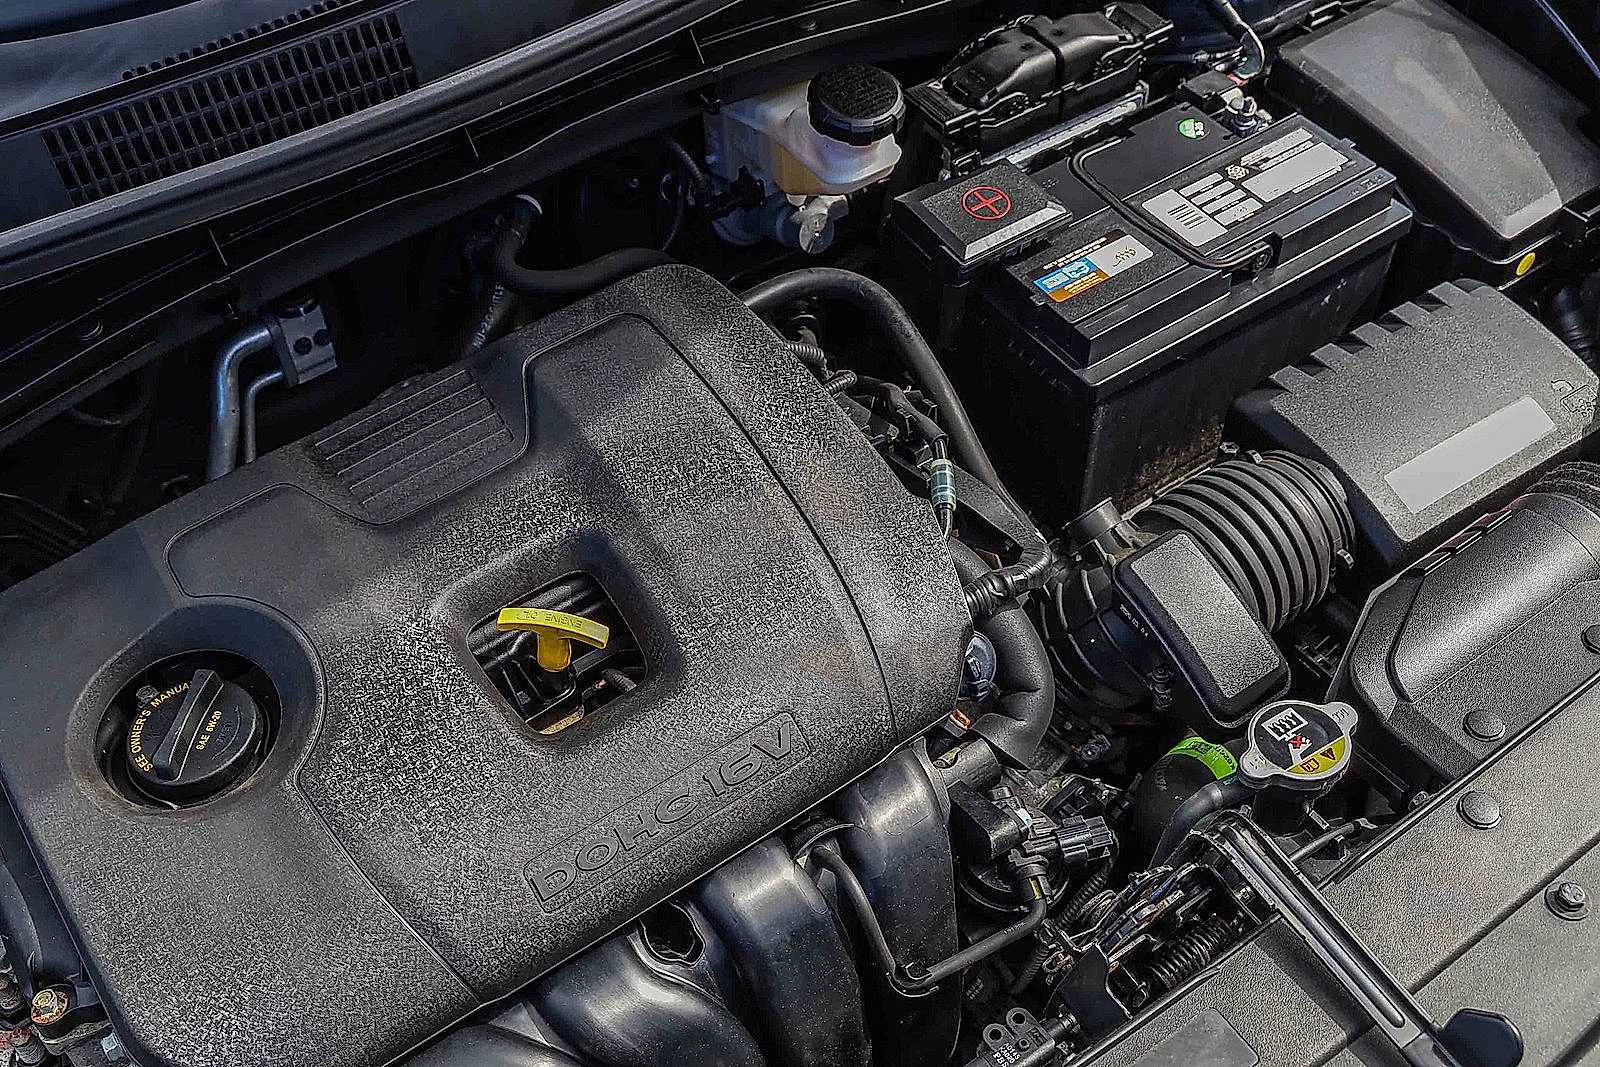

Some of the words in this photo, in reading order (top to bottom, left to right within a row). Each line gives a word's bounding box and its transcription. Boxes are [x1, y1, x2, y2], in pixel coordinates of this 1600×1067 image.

[544, 612, 583, 629] ENGINE
[150, 681, 191, 708] MANUA
[130, 709, 152, 754] OWNER'S
[195, 734, 210, 751] SAE
[134, 753, 154, 772] SEE
[530, 787, 699, 901] DOHC
[702, 721, 793, 798] 16V
